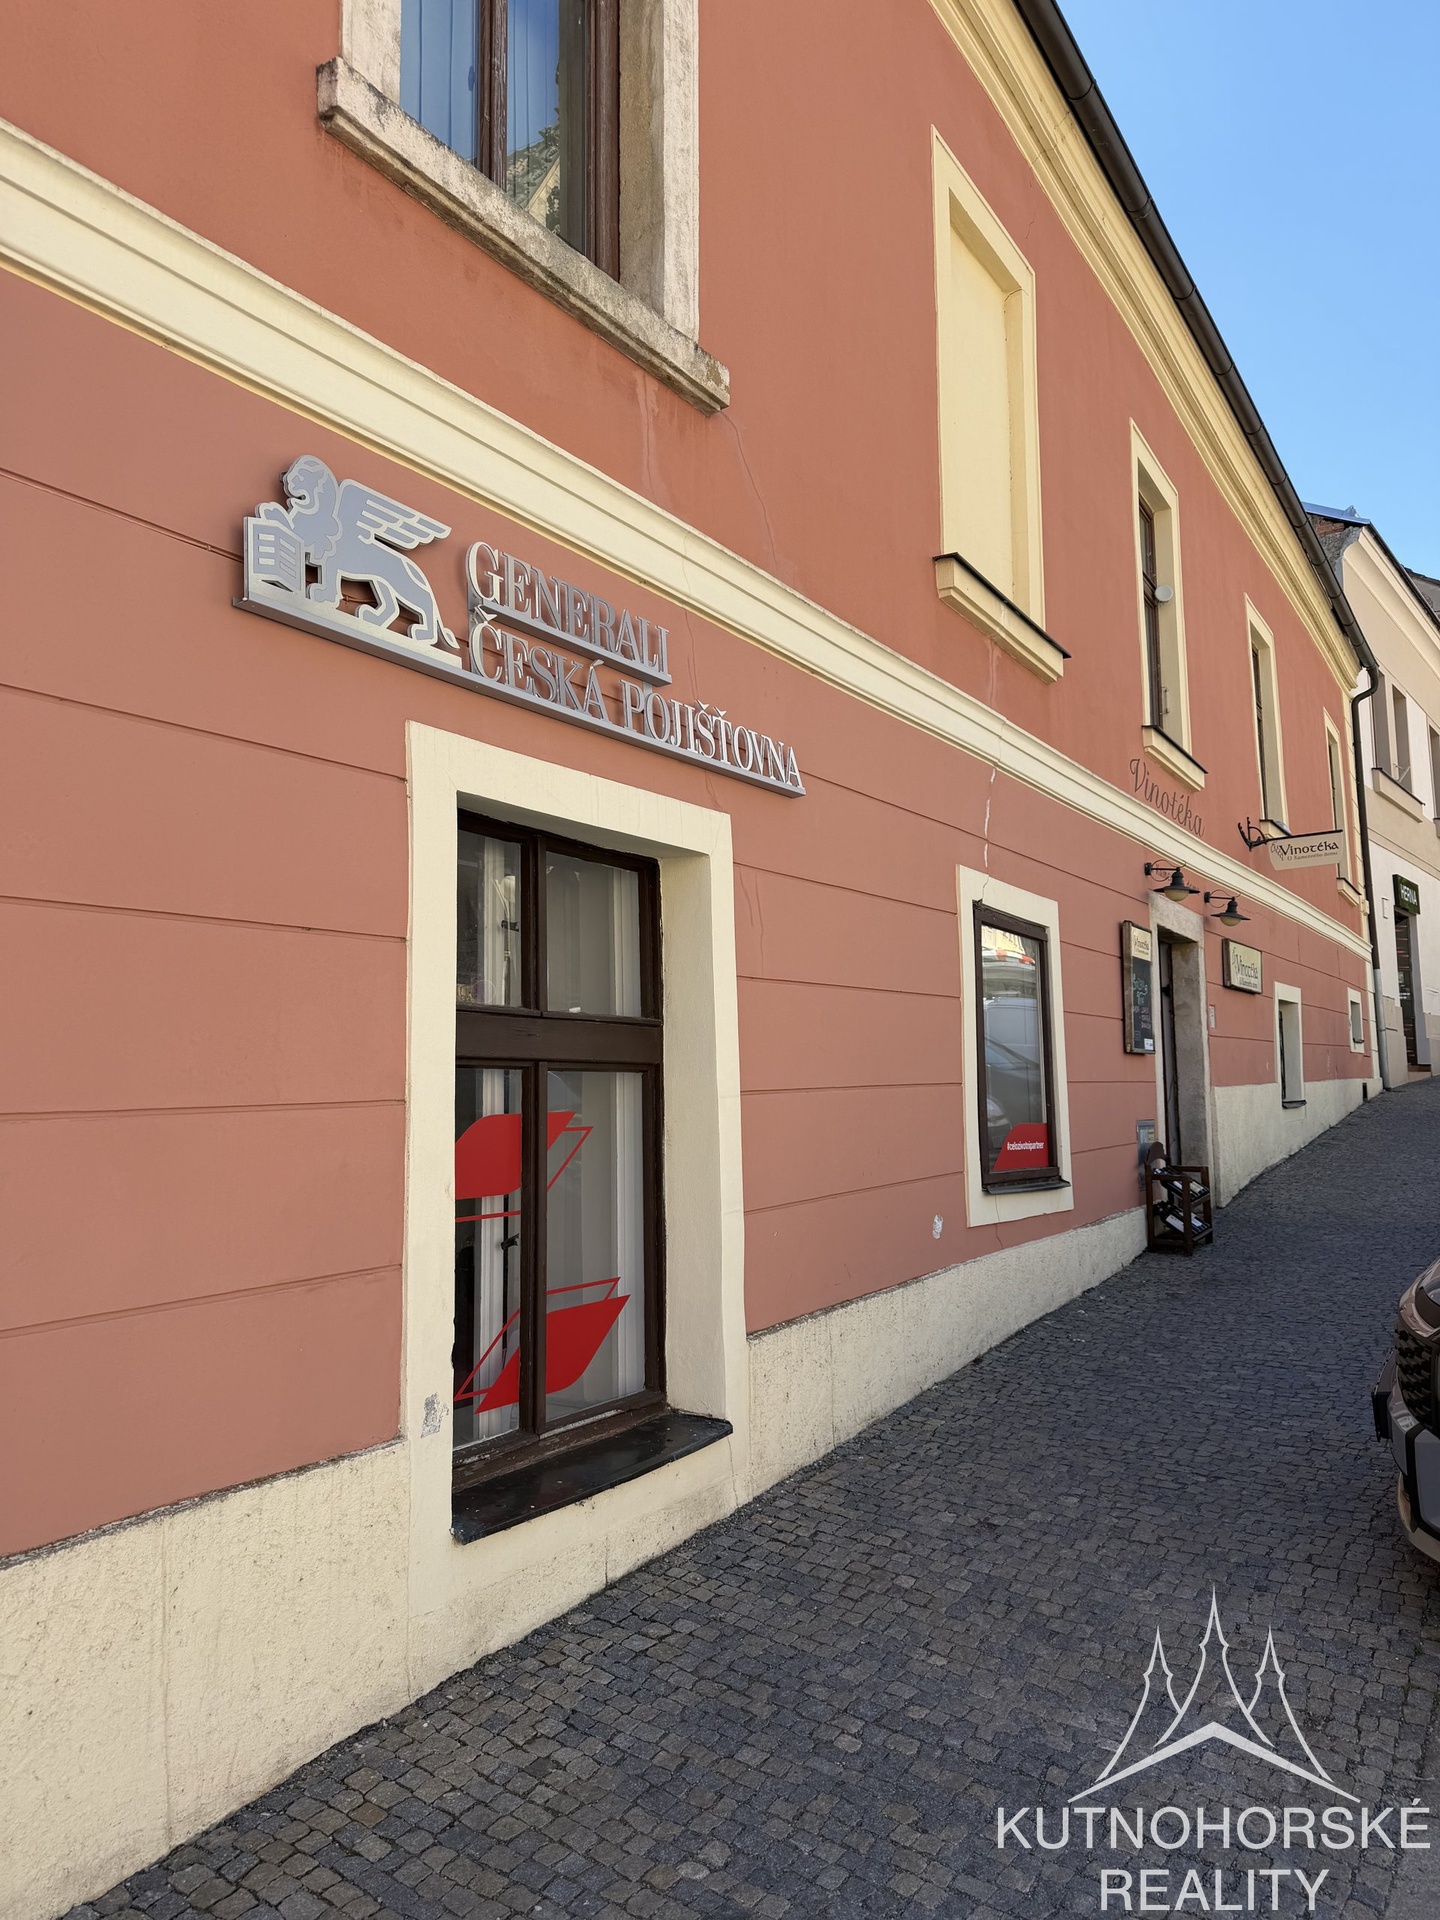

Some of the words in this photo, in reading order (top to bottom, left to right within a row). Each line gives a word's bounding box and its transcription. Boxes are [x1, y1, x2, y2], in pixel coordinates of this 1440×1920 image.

[467, 542, 669, 673] GENERALI
[470, 604, 610, 721] ČESKÁ
[619, 679, 804, 788] POJIŠŤOVNA
[1129, 758, 1205, 838] Vinotéka
[1279, 841, 1339, 855] Vinotéka
